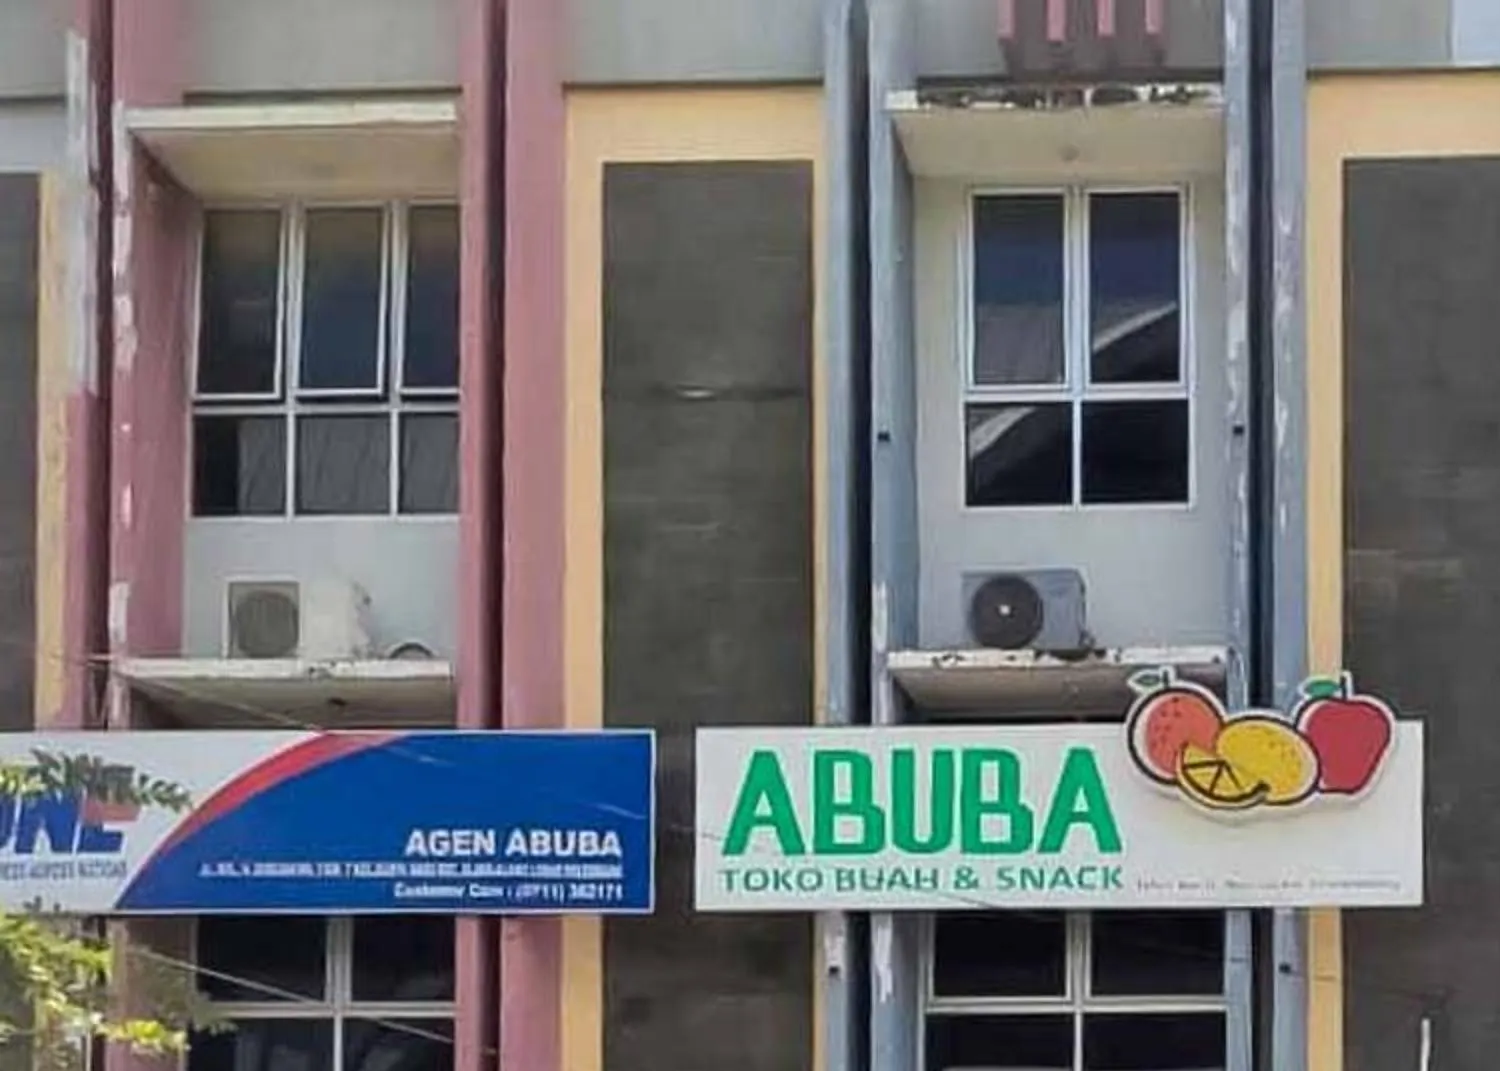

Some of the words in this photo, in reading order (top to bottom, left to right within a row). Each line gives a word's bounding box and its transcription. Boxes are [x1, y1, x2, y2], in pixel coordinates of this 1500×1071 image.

[722, 748, 1123, 856] ABUBA
[404, 828, 496, 857] AGEN
[505, 828, 622, 857] ABUBA
[721, 867, 822, 893] TOKO
[835, 866, 939, 893] BUAH
[952, 866, 980, 890] &
[997, 865, 1123, 890] SNACK
